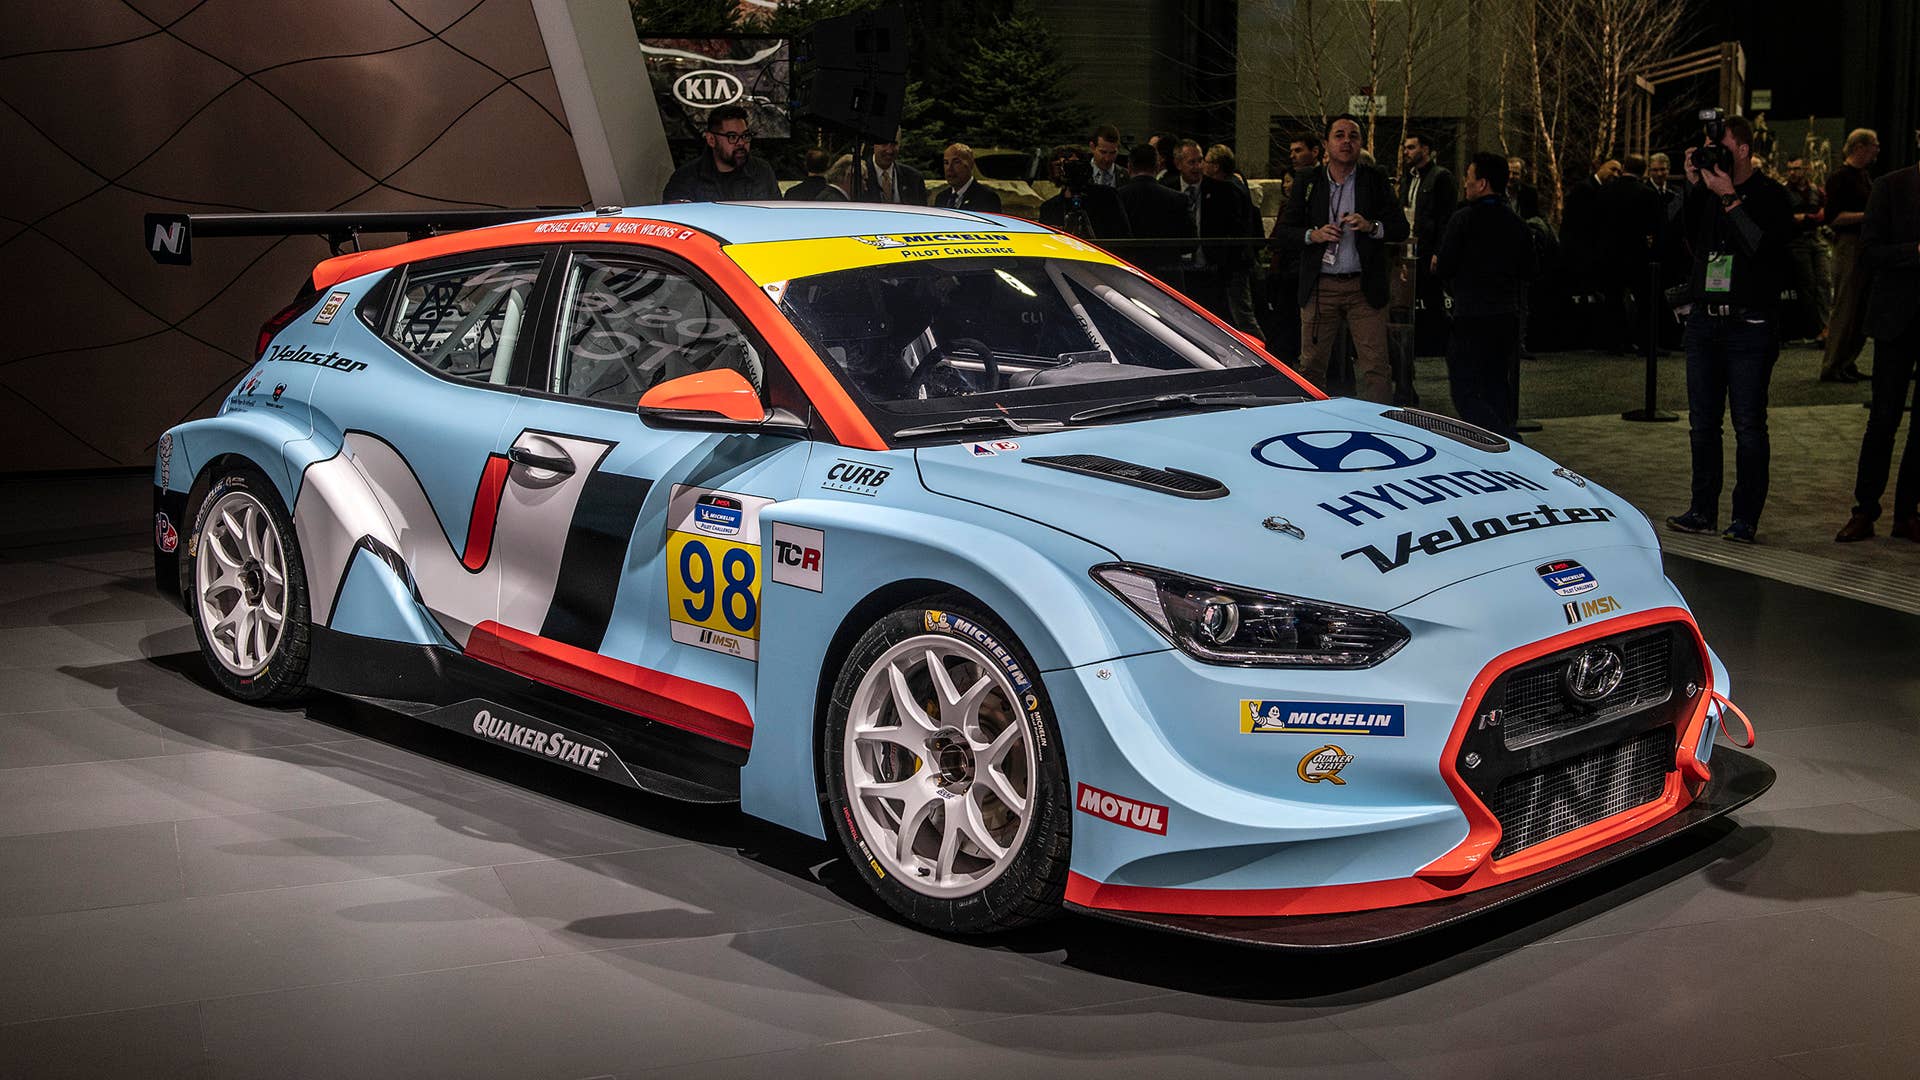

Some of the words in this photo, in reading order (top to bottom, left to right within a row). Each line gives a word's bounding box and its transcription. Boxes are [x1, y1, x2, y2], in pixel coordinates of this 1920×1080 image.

[685, 78, 732, 100] KIA
[152, 222, 186, 254] N
[534, 221, 571, 233] MICHAEL
[570, 221, 599, 233] LEWIS
[612, 222, 642, 234] MARK
[640, 223, 679, 238] WILKINS
[902, 233, 1010, 243] MICHELIN
[901, 249, 939, 258] PILOT
[943, 247, 1016, 256] CHALLENGE
[268, 344, 368, 372] Veloster
[827, 463, 890, 487] CURB
[1316, 469, 1549, 527] HYUNDAI
[709, 513, 736, 521] MICHELIN
[1340, 504, 1616, 574] Veloster
[775, 539, 821, 572] TCR
[680, 540, 756, 632] 98
[1561, 573, 1585, 582] MICHELIN
[1581, 595, 1621, 618] IMSA
[712, 634, 741, 650] IMSA
[954, 618, 1028, 685] MICHELIN
[1287, 712, 1391, 727] MICHELIN
[1312, 754, 1354, 763] QUAKER
[1315, 762, 1345, 770] STATE
[1080, 788, 1162, 831] MOTUL
